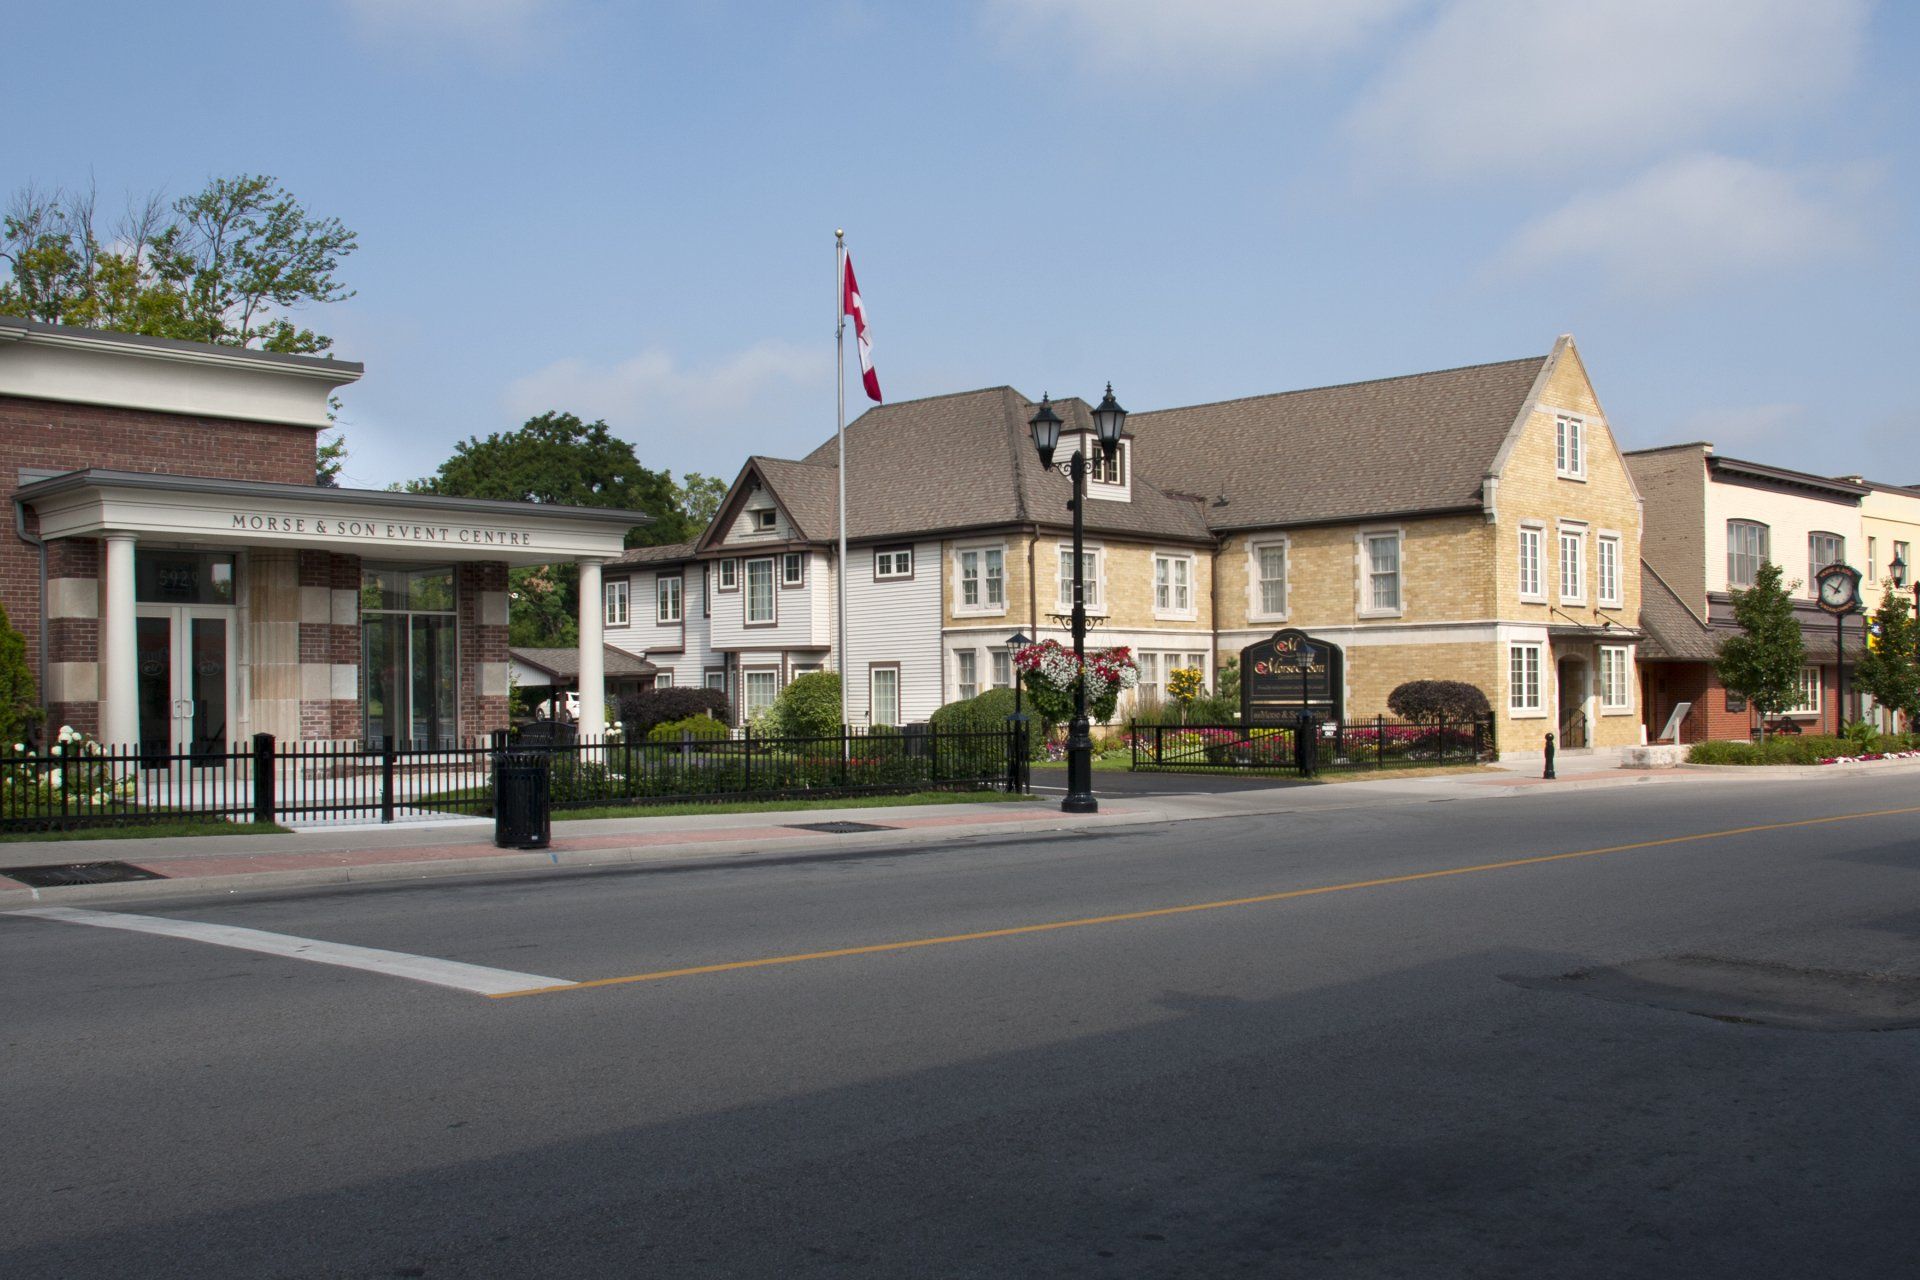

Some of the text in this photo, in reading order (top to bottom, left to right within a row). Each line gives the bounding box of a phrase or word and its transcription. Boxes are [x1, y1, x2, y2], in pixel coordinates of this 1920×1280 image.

[232, 515, 531, 545] MORSE & SON EVENT CENTRE
